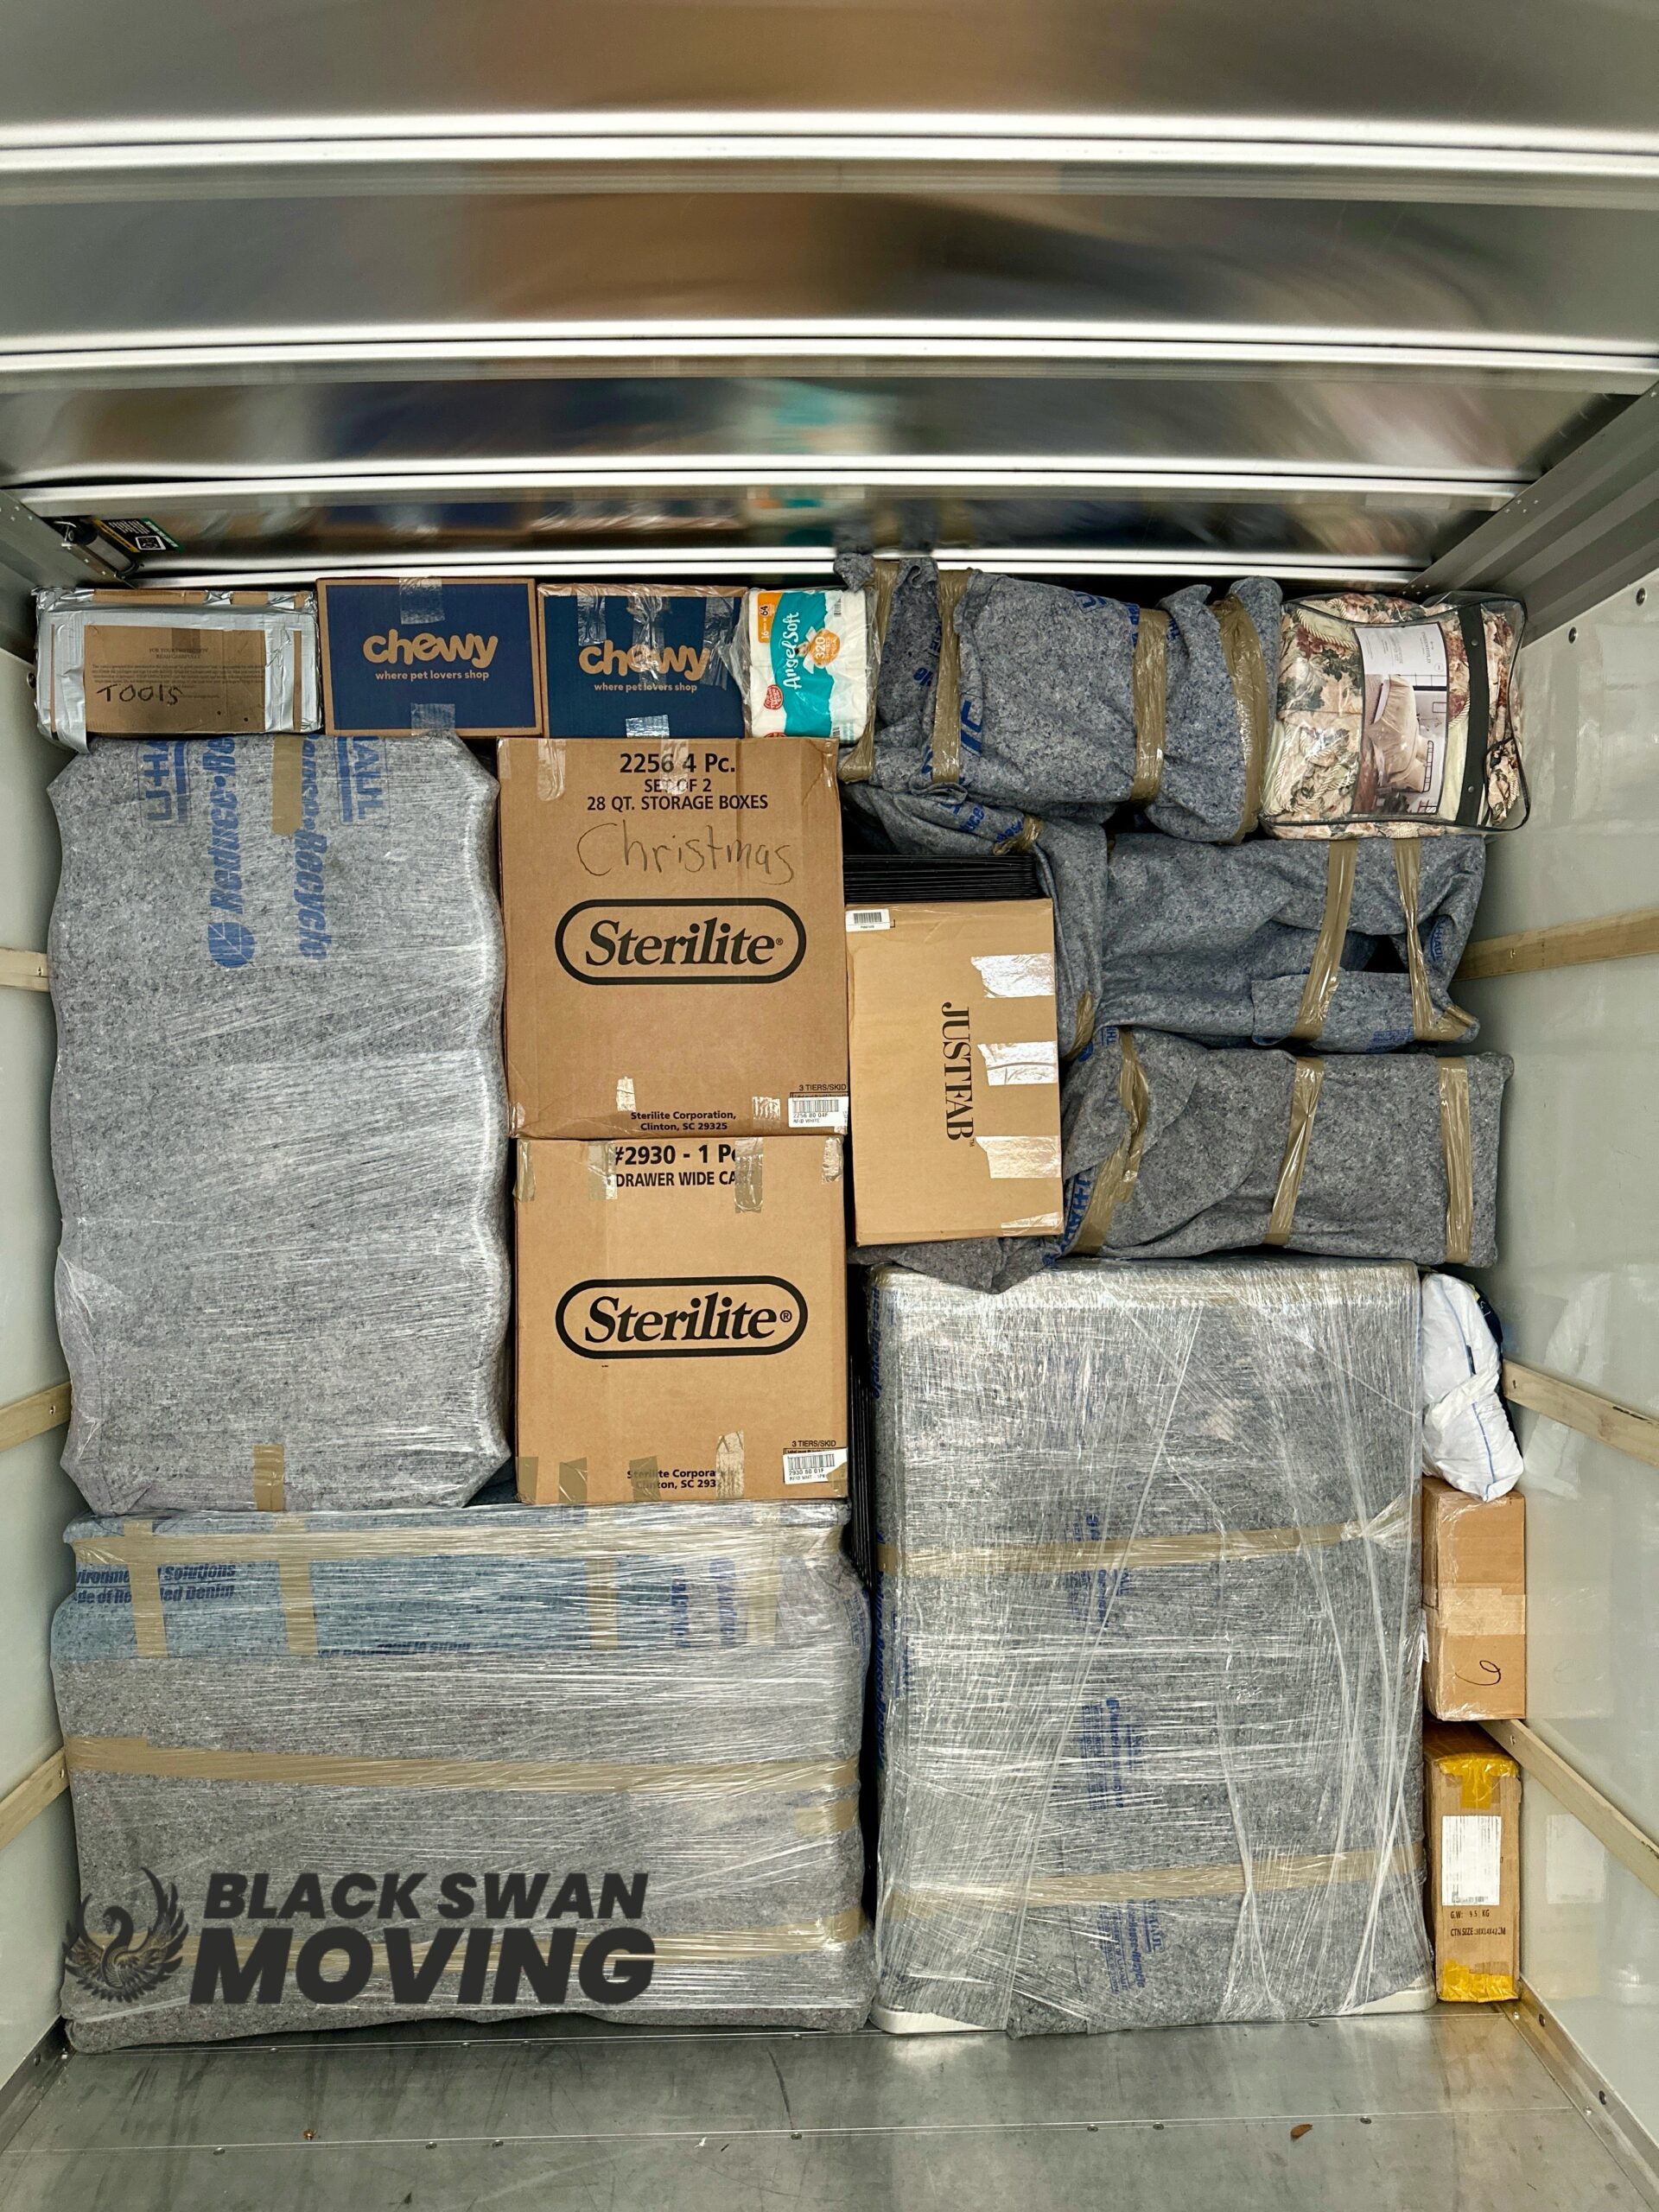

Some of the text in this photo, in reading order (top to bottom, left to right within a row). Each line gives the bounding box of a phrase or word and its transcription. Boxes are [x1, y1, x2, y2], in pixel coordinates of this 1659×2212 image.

[760, 605, 769, 616] 64
[363, 628, 499, 669] chewy
[782, 612, 802, 690] Angel Soft
[815, 636, 826, 659] 320
[579, 639, 711, 681] chewy
[375, 670, 490, 682] where pet lovers shop
[594, 682, 697, 693] where pet lovers shop
[620, 753, 735, 773] 2256 4 Pc.
[702, 778, 712, 792] 2
[587, 794, 768, 812] 28 QT. STORAGE BOXES
[576, 819, 794, 886] Christmas
[631, 1109, 736, 1121] Sterilite Corporation,
[640, 1122, 728, 1132] Clinton, SC 29325
[615, 1146, 677, 1166] #2930
[698, 1144, 709, 1163] 1
[616, 1172, 675, 1187] DRAWER
[678, 1171, 715, 1185] WIDE
[681, 1479, 694, 1488] SC
[165, 1563, 236, 1581] Solutions
[186, 1584, 235, 1600] Denim
[1482, 1909, 1490, 1917] KG
[1450, 1928, 1461, 1936] CTN
